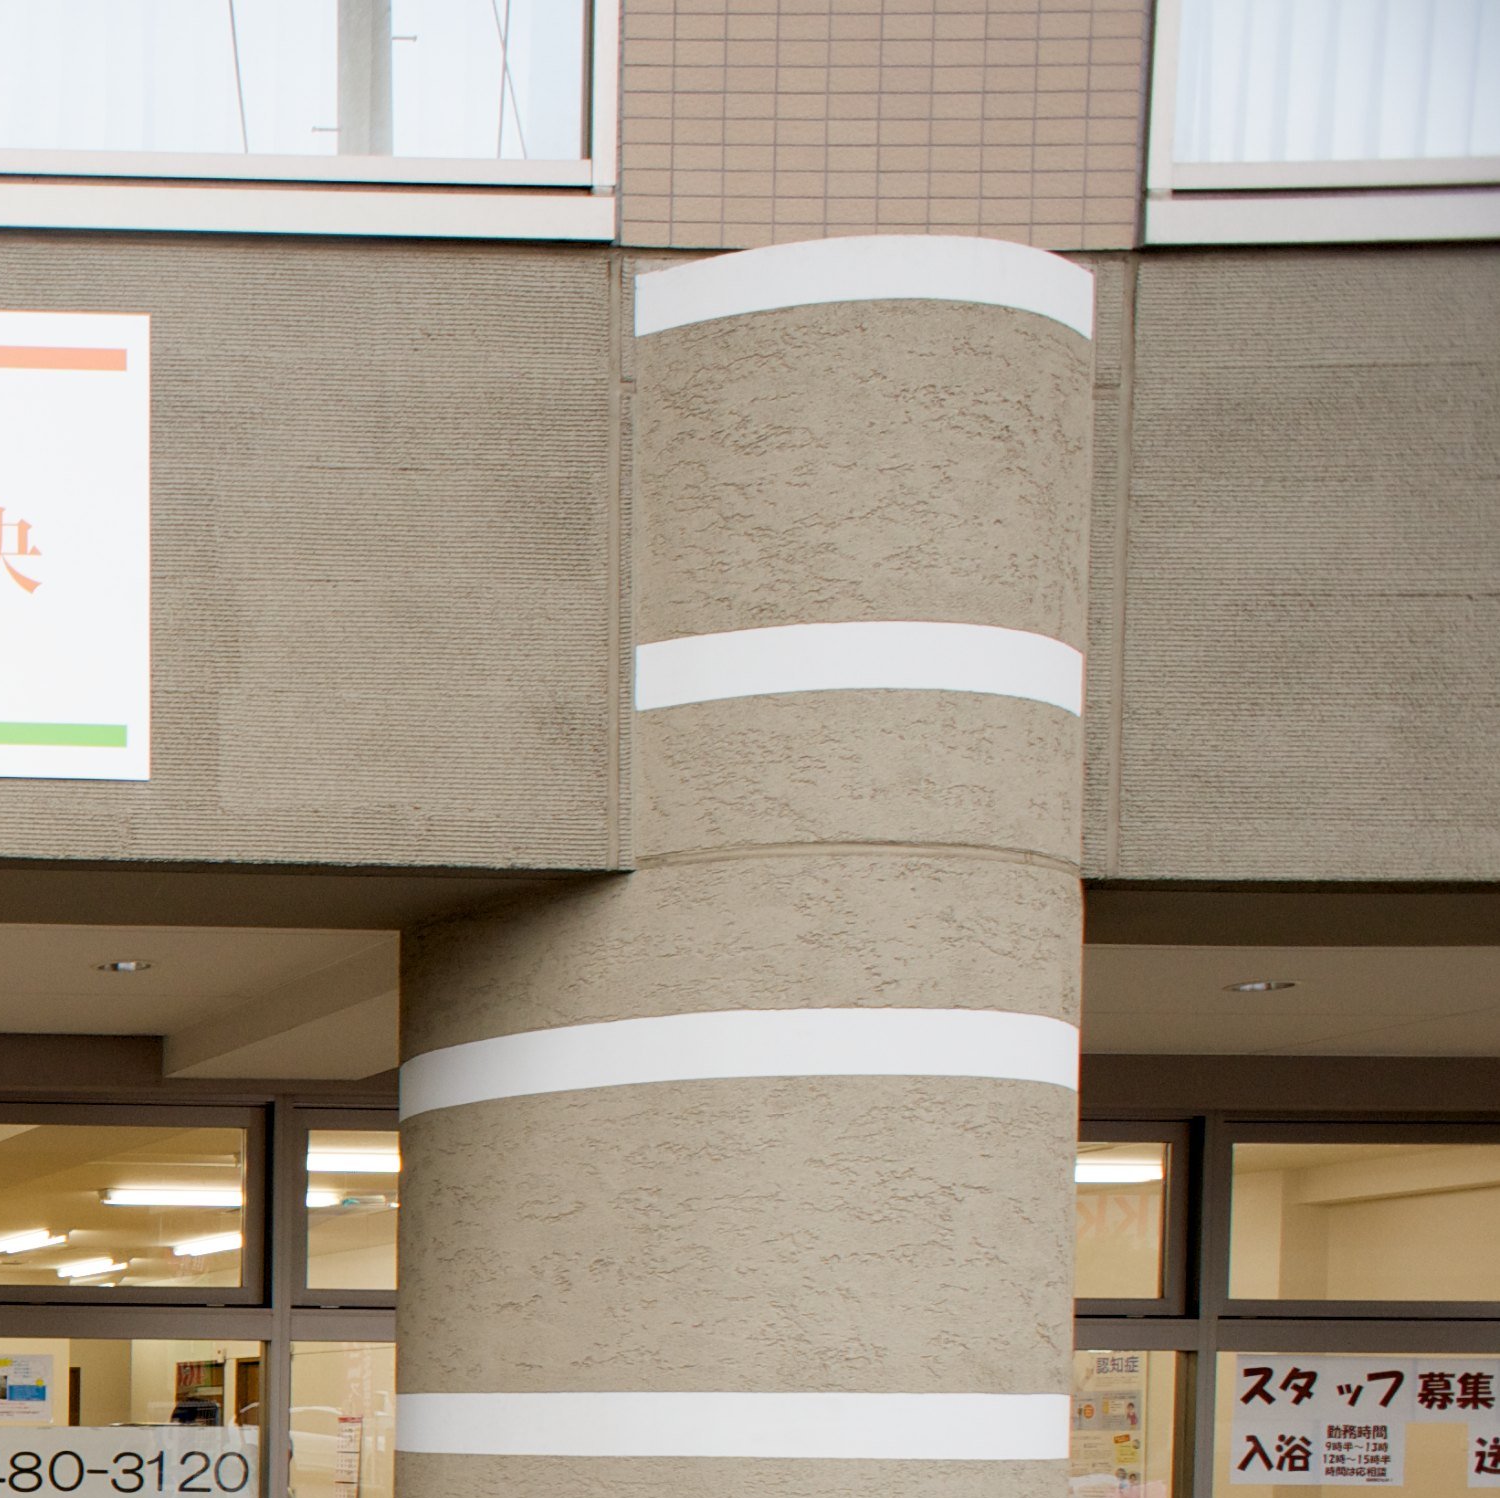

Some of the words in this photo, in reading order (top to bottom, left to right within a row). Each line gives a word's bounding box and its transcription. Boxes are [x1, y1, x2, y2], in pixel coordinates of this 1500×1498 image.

[1096, 1356, 1139, 1374] 認知症
[1327, 1424, 1387, 1439] 勤務時間
[1237, 1434, 1312, 1472] 入浴
